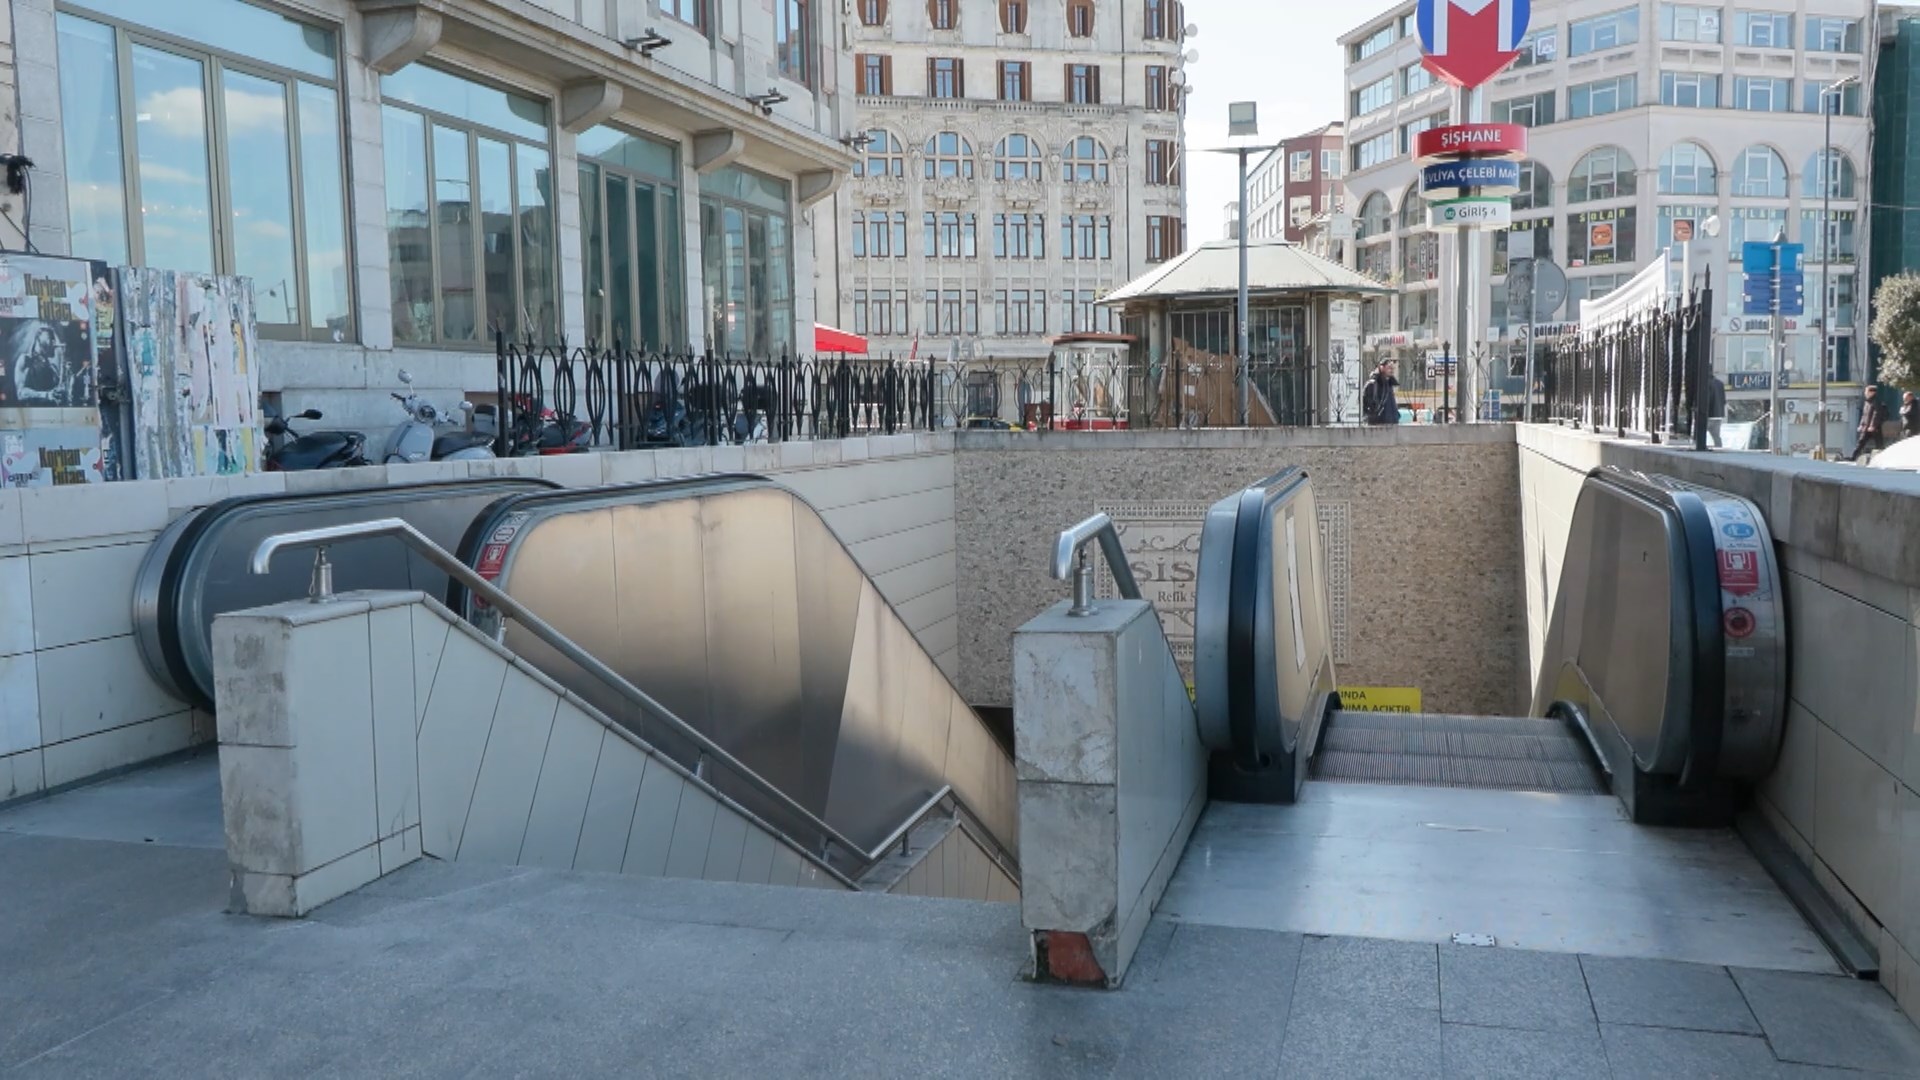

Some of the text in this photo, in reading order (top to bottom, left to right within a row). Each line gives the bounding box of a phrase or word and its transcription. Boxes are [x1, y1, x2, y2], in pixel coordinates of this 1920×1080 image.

[1441, 129, 1502, 148] ŞİŞHANE
[1458, 165, 1496, 182] ÇELEBİ
[1458, 205, 1488, 219] GİRİŞ
[1490, 208, 1497, 217] 4
[1158, 591, 1188, 602] Refik
[1341, 691, 1367, 700] INDA
